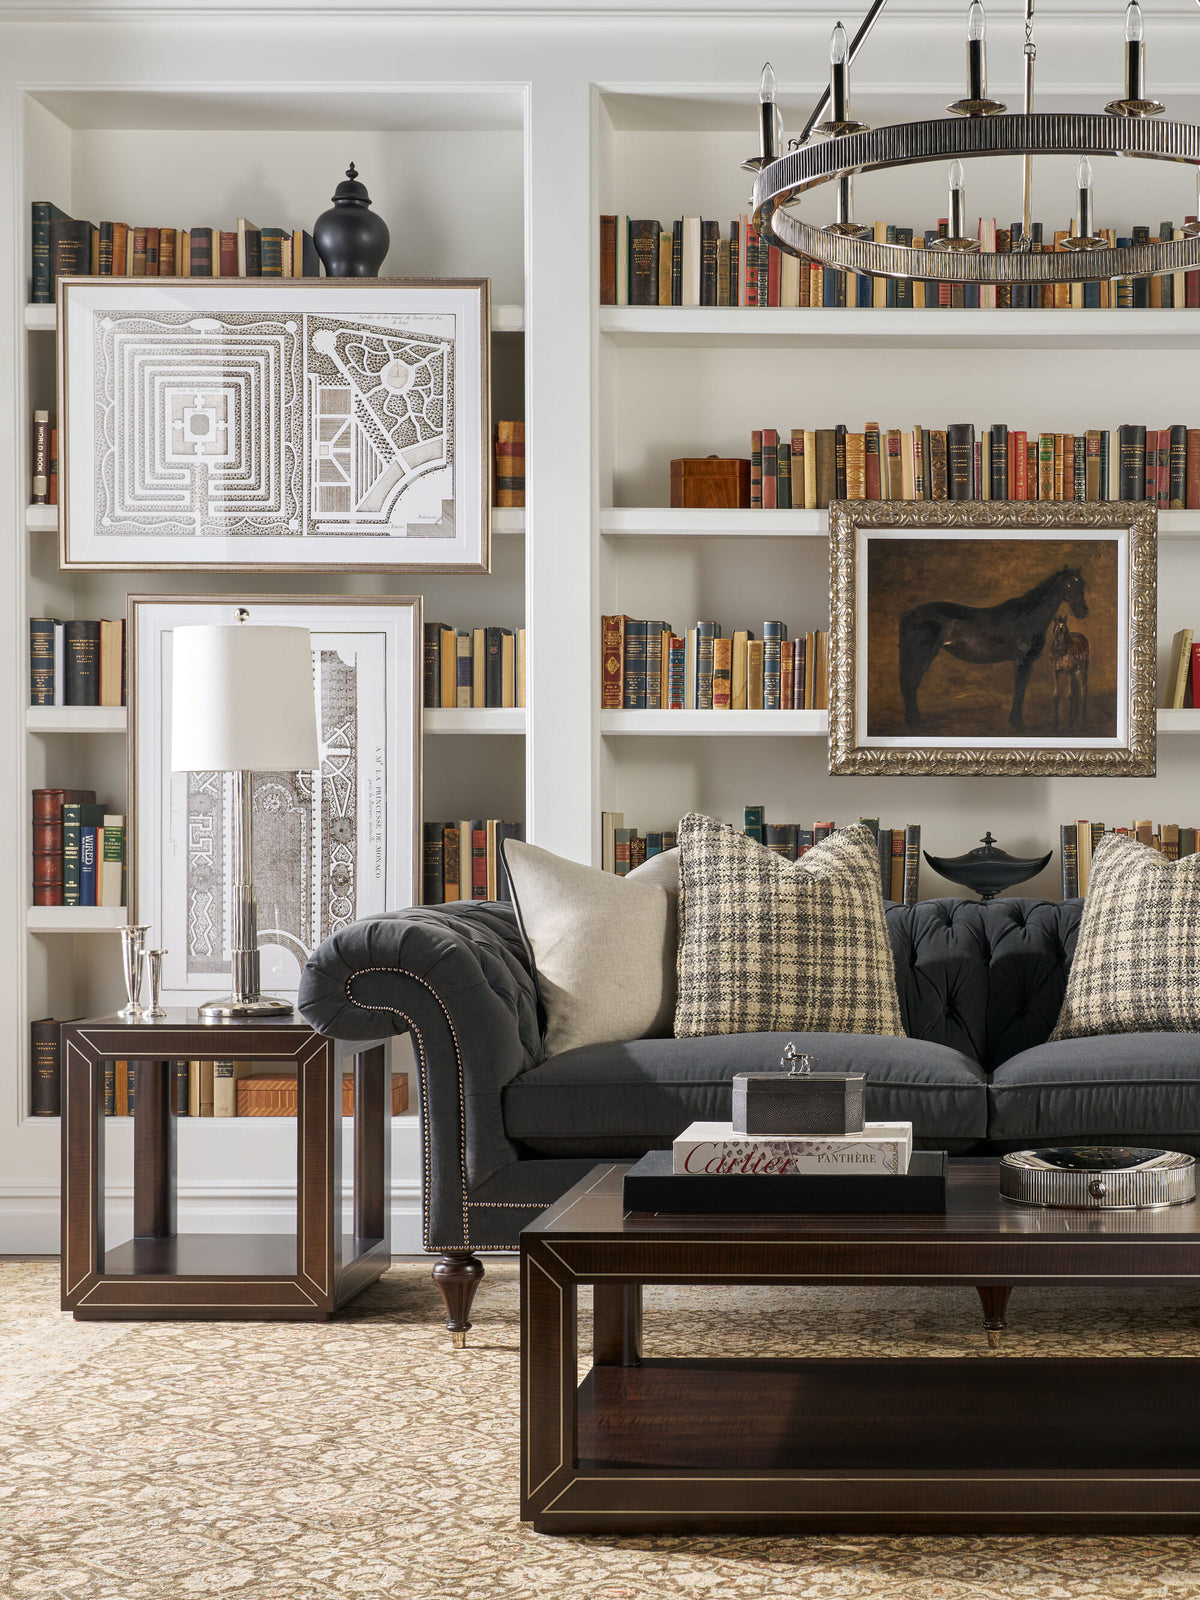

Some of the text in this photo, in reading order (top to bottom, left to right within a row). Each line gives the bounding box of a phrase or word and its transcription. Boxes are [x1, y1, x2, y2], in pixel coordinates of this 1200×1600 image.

[85, 835, 94, 865] WIRED
[375, 832, 382, 843] DE
[684, 1142, 877, 1175] Cartier PANTHÈRE
